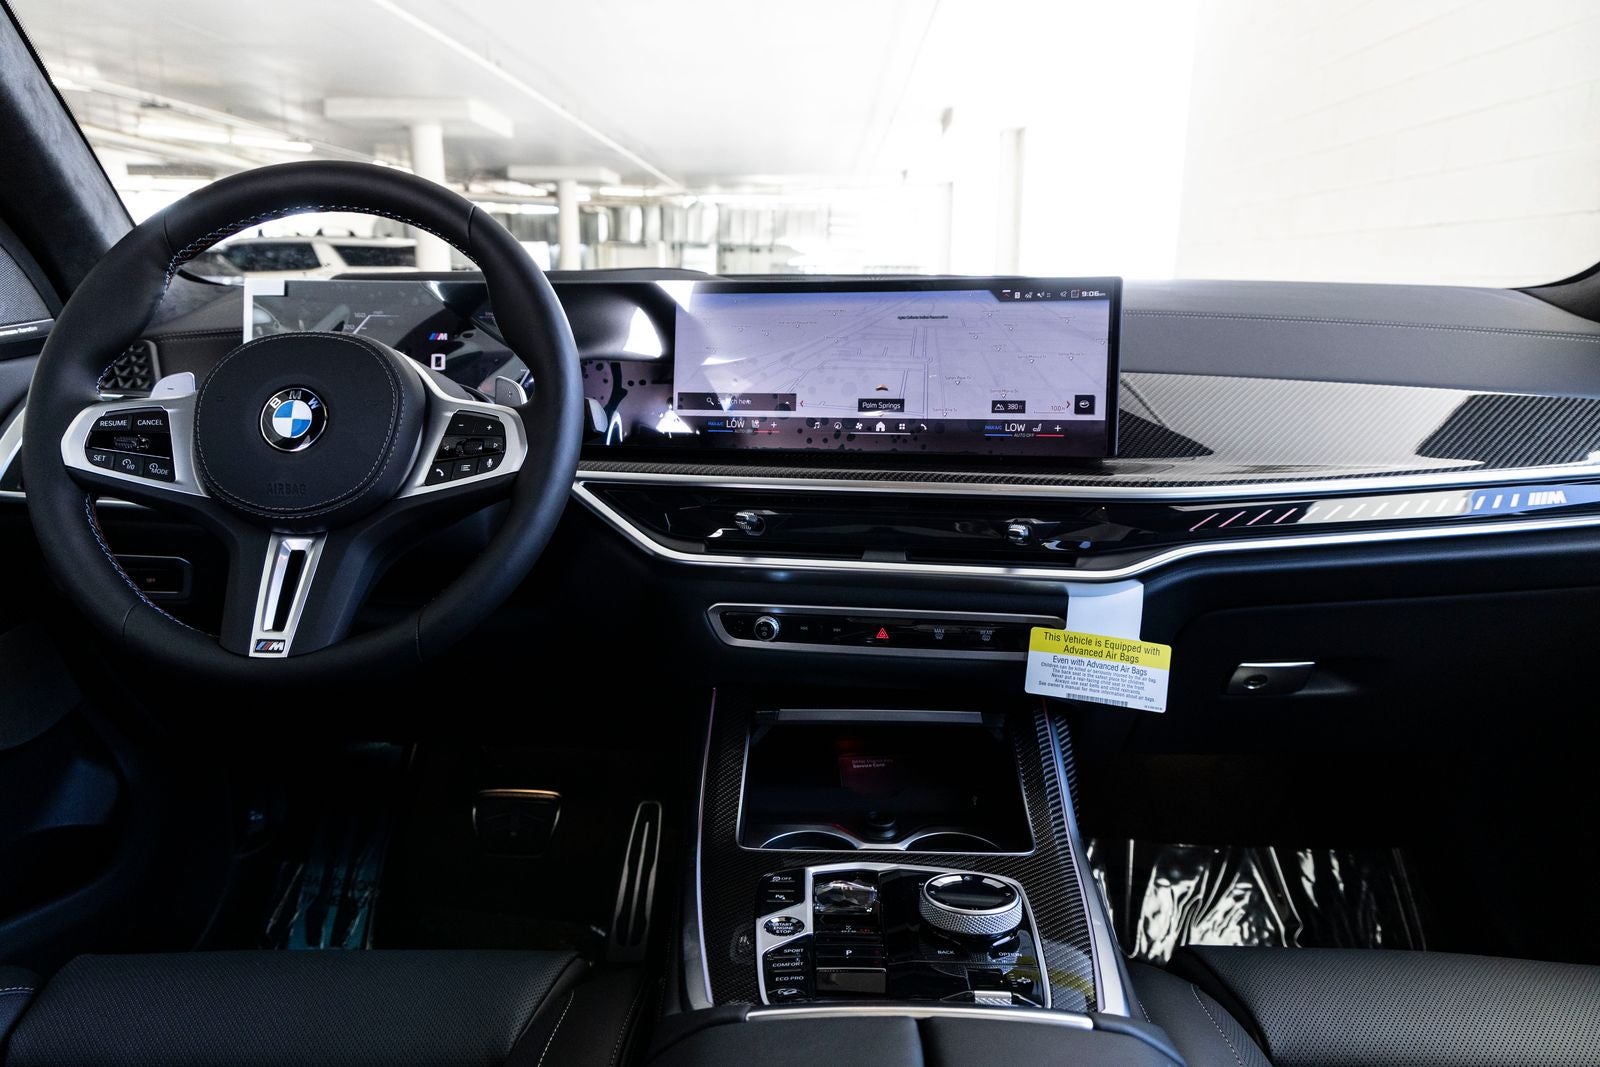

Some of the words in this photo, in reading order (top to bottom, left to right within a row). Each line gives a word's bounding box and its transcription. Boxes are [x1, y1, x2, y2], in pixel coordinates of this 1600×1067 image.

[430, 354, 446, 370] 0
[270, 390, 321, 410] BMW
[878, 402, 901, 410] Springs
[726, 420, 745, 428] LOW
[1004, 423, 1026, 432] LOW
[266, 482, 306, 496] AIRBAG
[1043, 631, 1060, 641] This
[1063, 634, 1092, 645] Vehicle
[1104, 639, 1141, 653] Equipped
[1143, 646, 1160, 655] with
[1063, 644, 1102, 657] Advanced
[1105, 650, 1116, 659] Air
[1119, 652, 1139, 664] Bags
[1052, 655, 1068, 663] Even
[1086, 660, 1118, 670] Advanced
[1131, 666, 1147, 676] Bags
